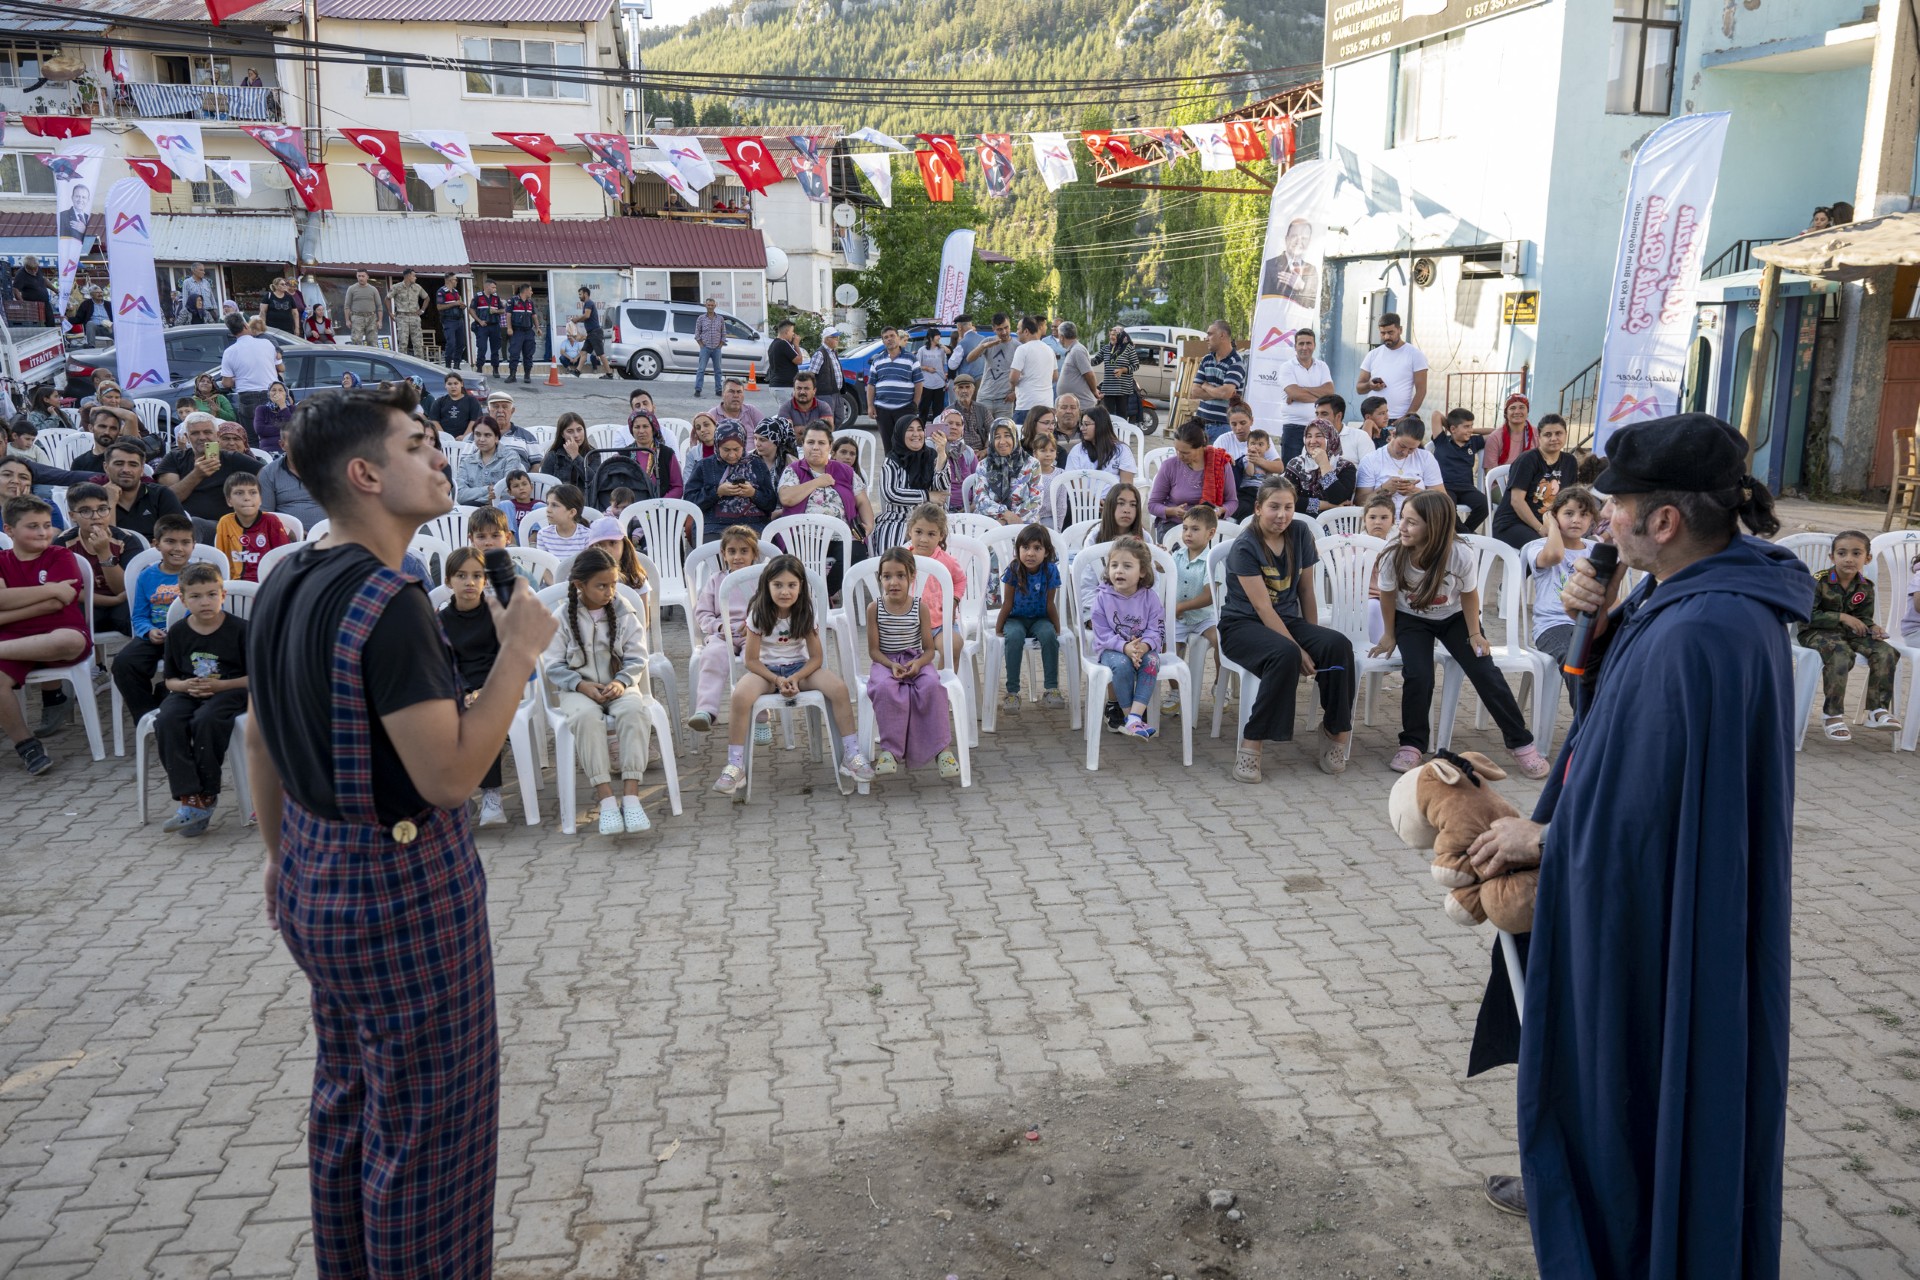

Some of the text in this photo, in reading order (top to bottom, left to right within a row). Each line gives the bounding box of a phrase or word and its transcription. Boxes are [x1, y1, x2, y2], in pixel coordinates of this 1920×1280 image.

[1333, 0, 1399, 25] ÇUKURABAN
[1340, 46, 1345, 58] 0
[29, 351, 54, 368] İTFAİYE
